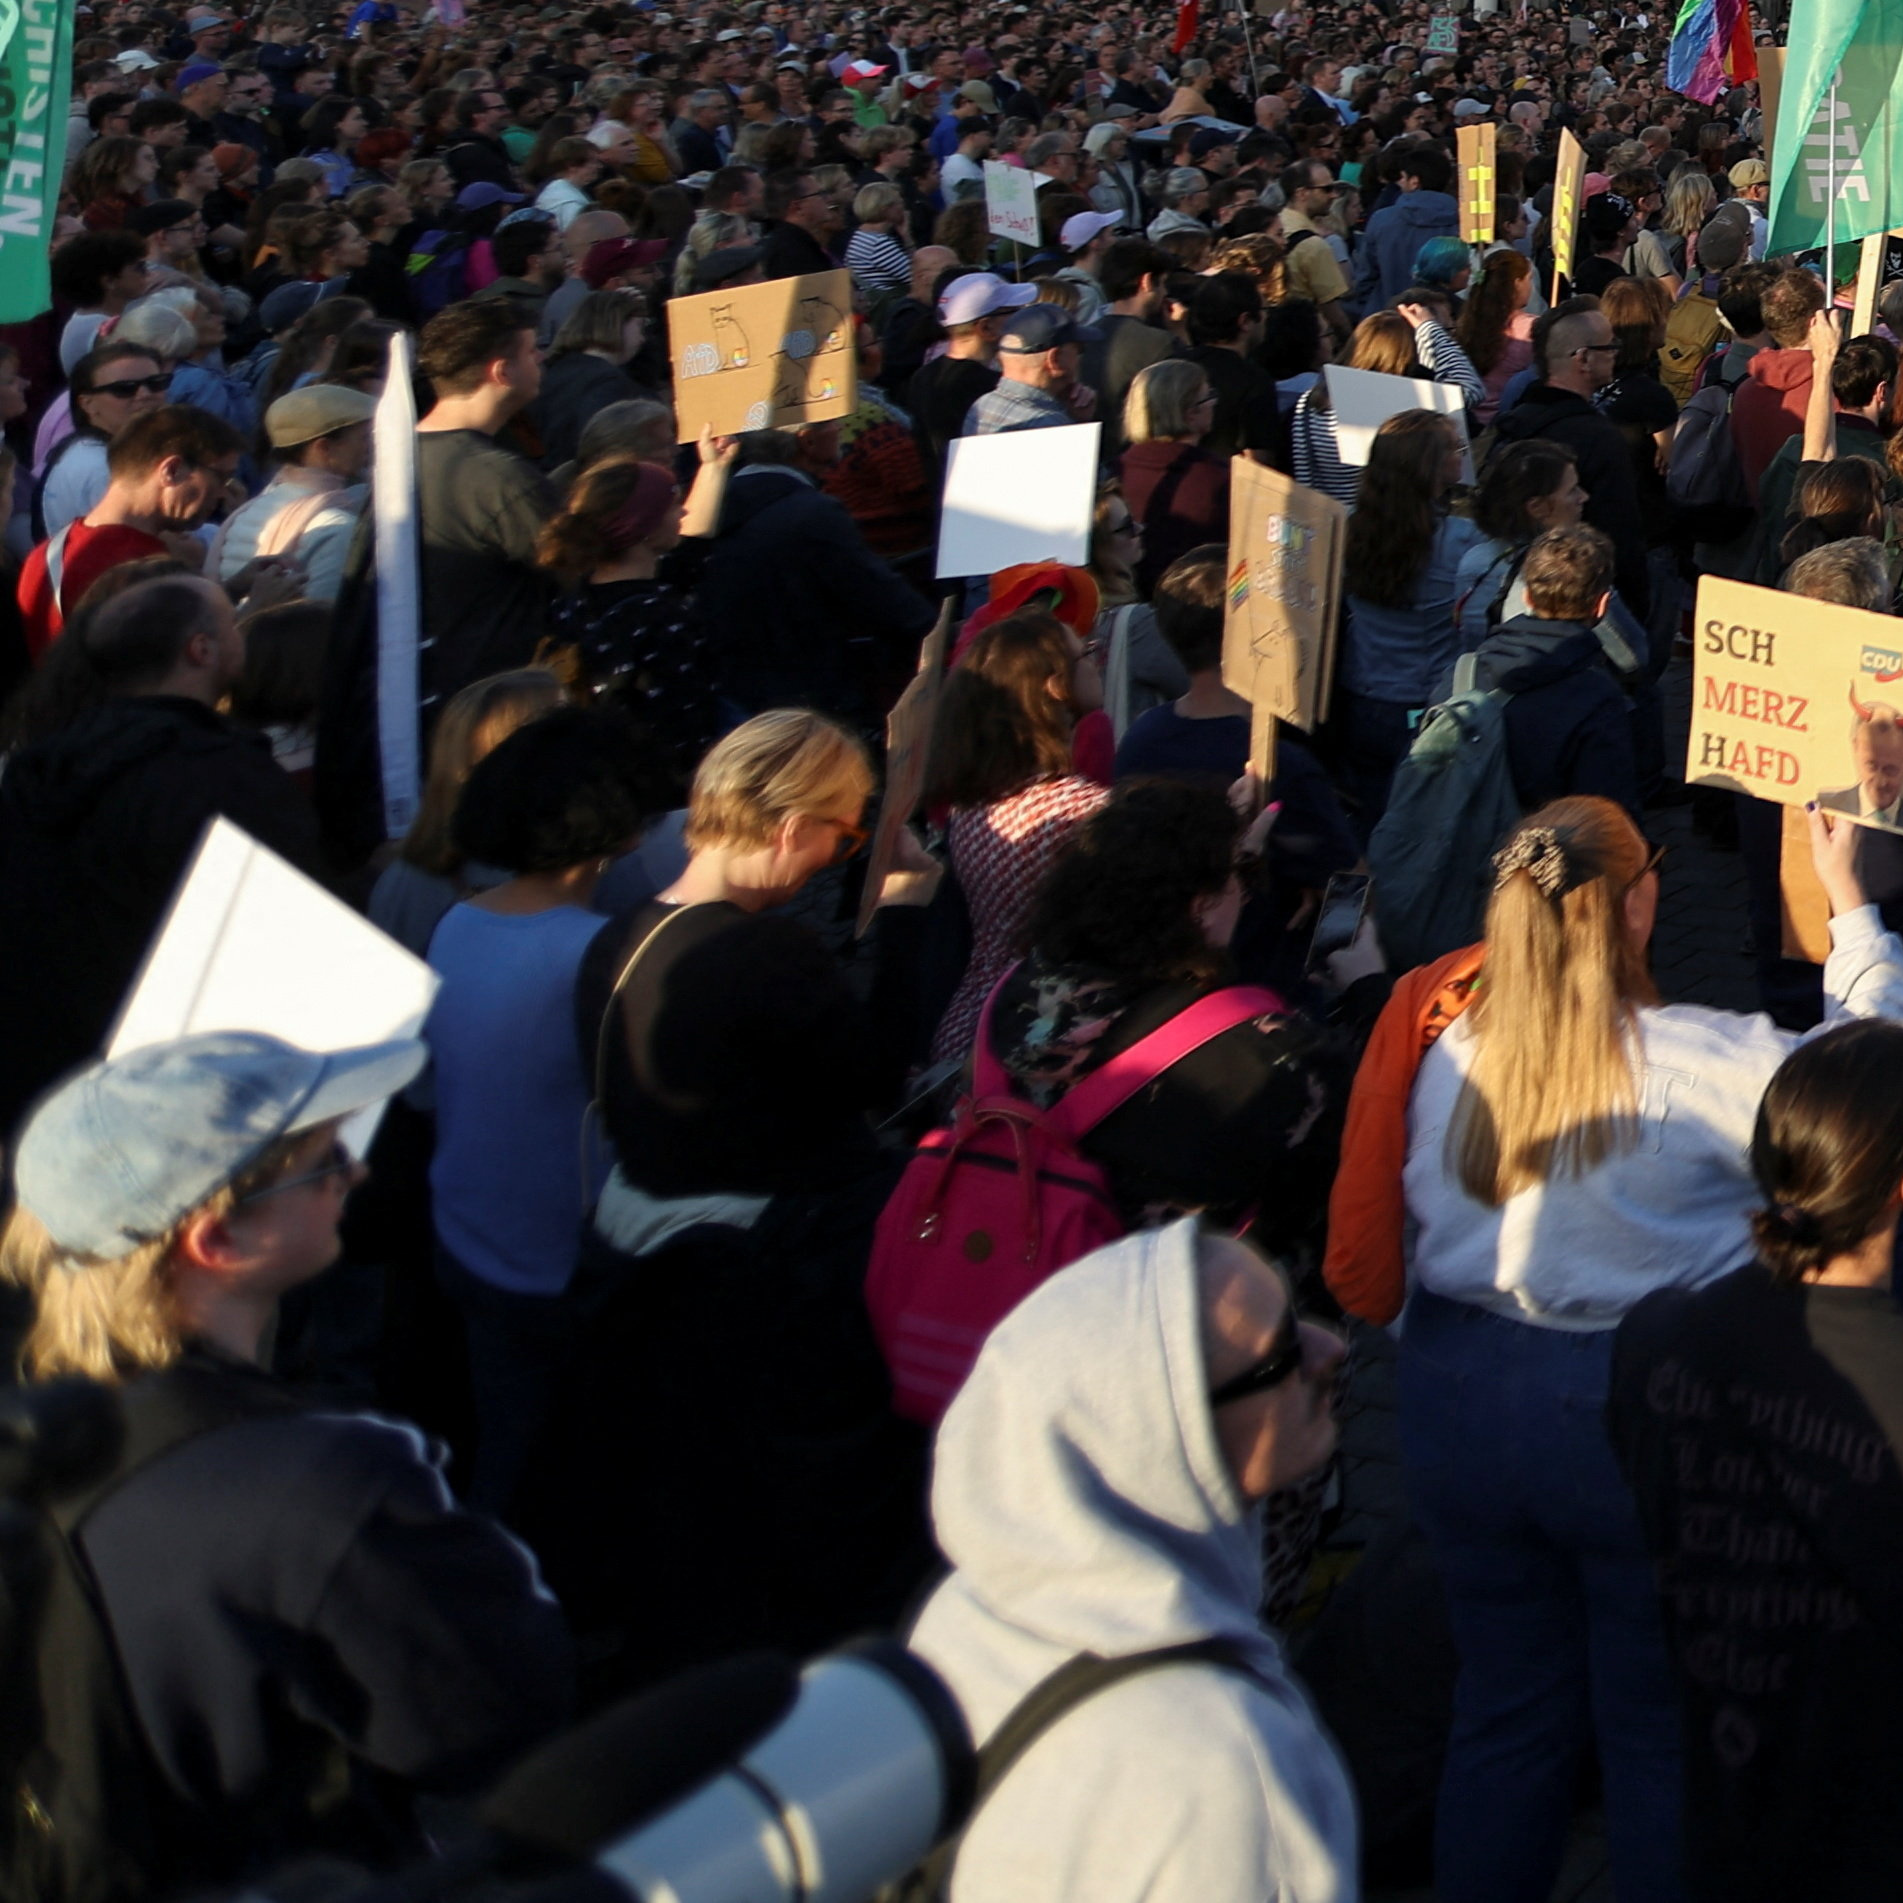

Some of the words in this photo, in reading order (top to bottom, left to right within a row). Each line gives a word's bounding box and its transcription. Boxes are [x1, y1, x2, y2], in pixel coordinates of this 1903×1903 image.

[1703, 619, 1776, 667] SCH
[1861, 650, 1901, 674] CDU
[1702, 675, 1809, 732] MERZ
[1699, 732, 1800, 786] HAFD
